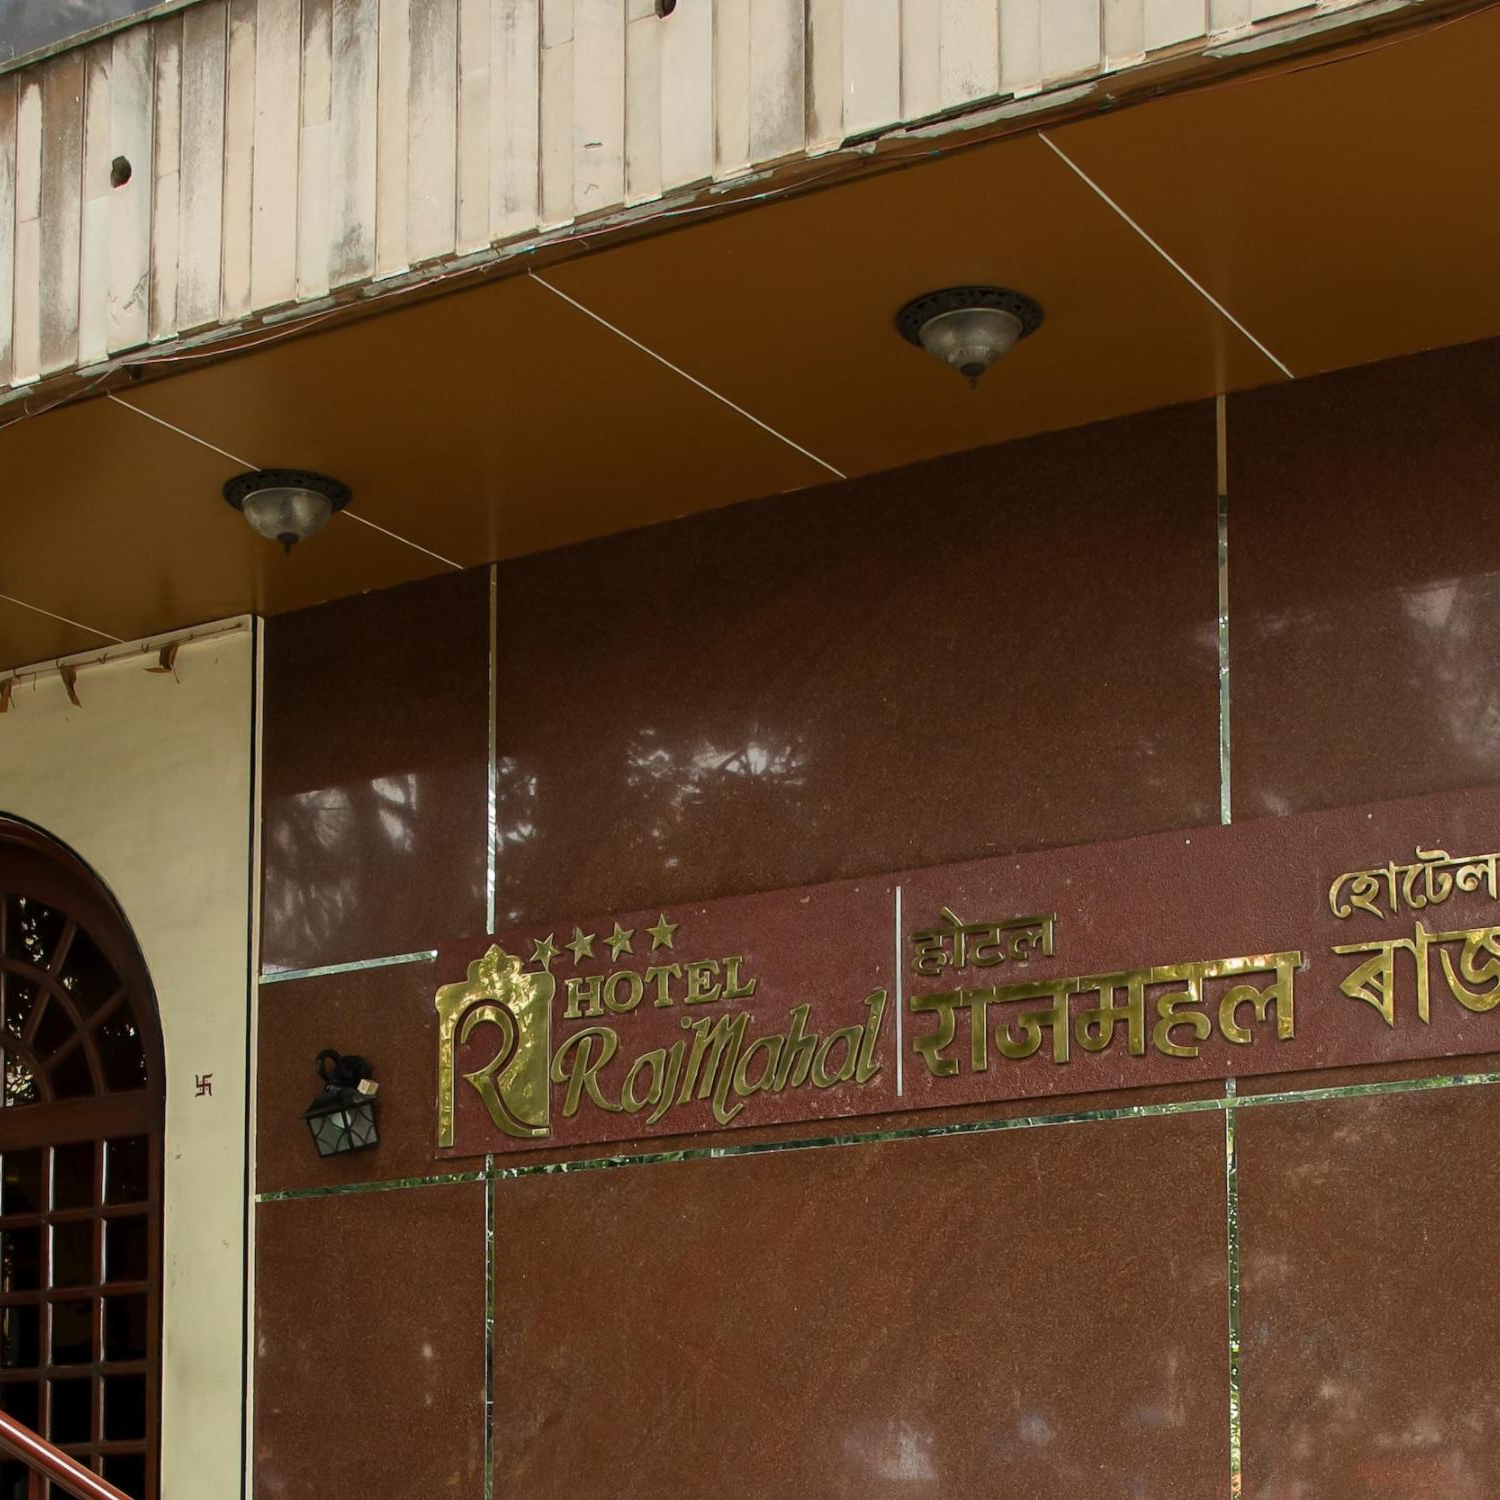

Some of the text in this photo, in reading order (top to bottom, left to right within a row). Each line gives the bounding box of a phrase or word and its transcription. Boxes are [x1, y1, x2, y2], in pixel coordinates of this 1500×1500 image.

[908, 906, 1057, 976] होटल
[563, 956, 757, 1019] HOTEL
[910, 950, 1302, 1076] राजमहल
